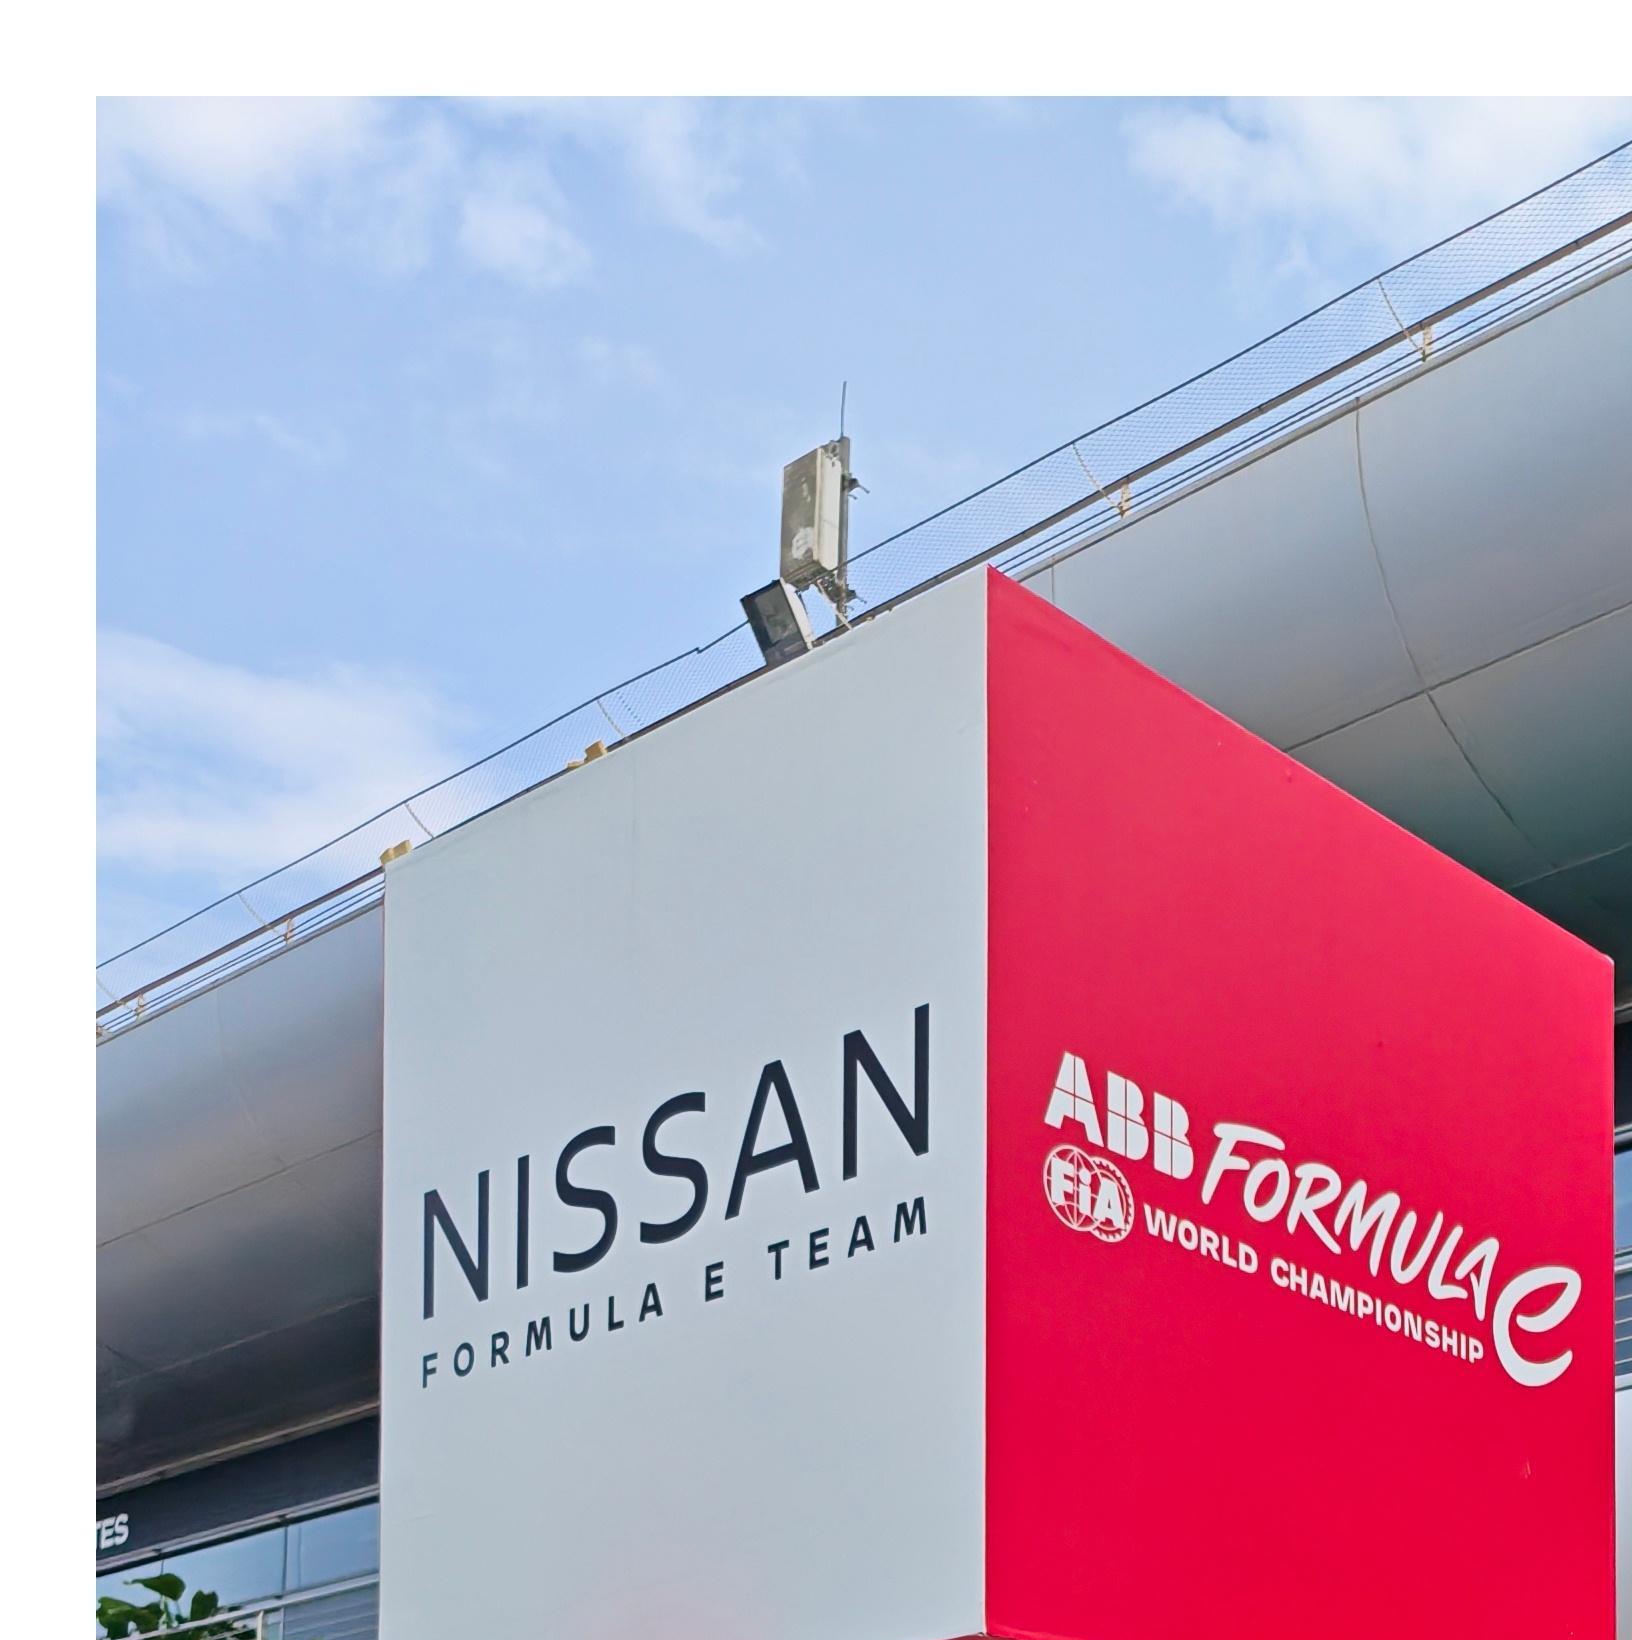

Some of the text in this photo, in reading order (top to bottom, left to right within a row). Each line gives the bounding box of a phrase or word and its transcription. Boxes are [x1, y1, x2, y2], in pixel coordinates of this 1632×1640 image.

[423, 1002, 930, 1320] NISSAN
[1044, 1051, 1195, 1181] ABB
[1201, 1122, 1500, 1322] FORMULA
[422, 1196, 928, 1389] FORMULA E TEAM
[1144, 1203, 1259, 1275] WORLD
[1269, 1257, 1485, 1364] CHAMPIONSHIP
